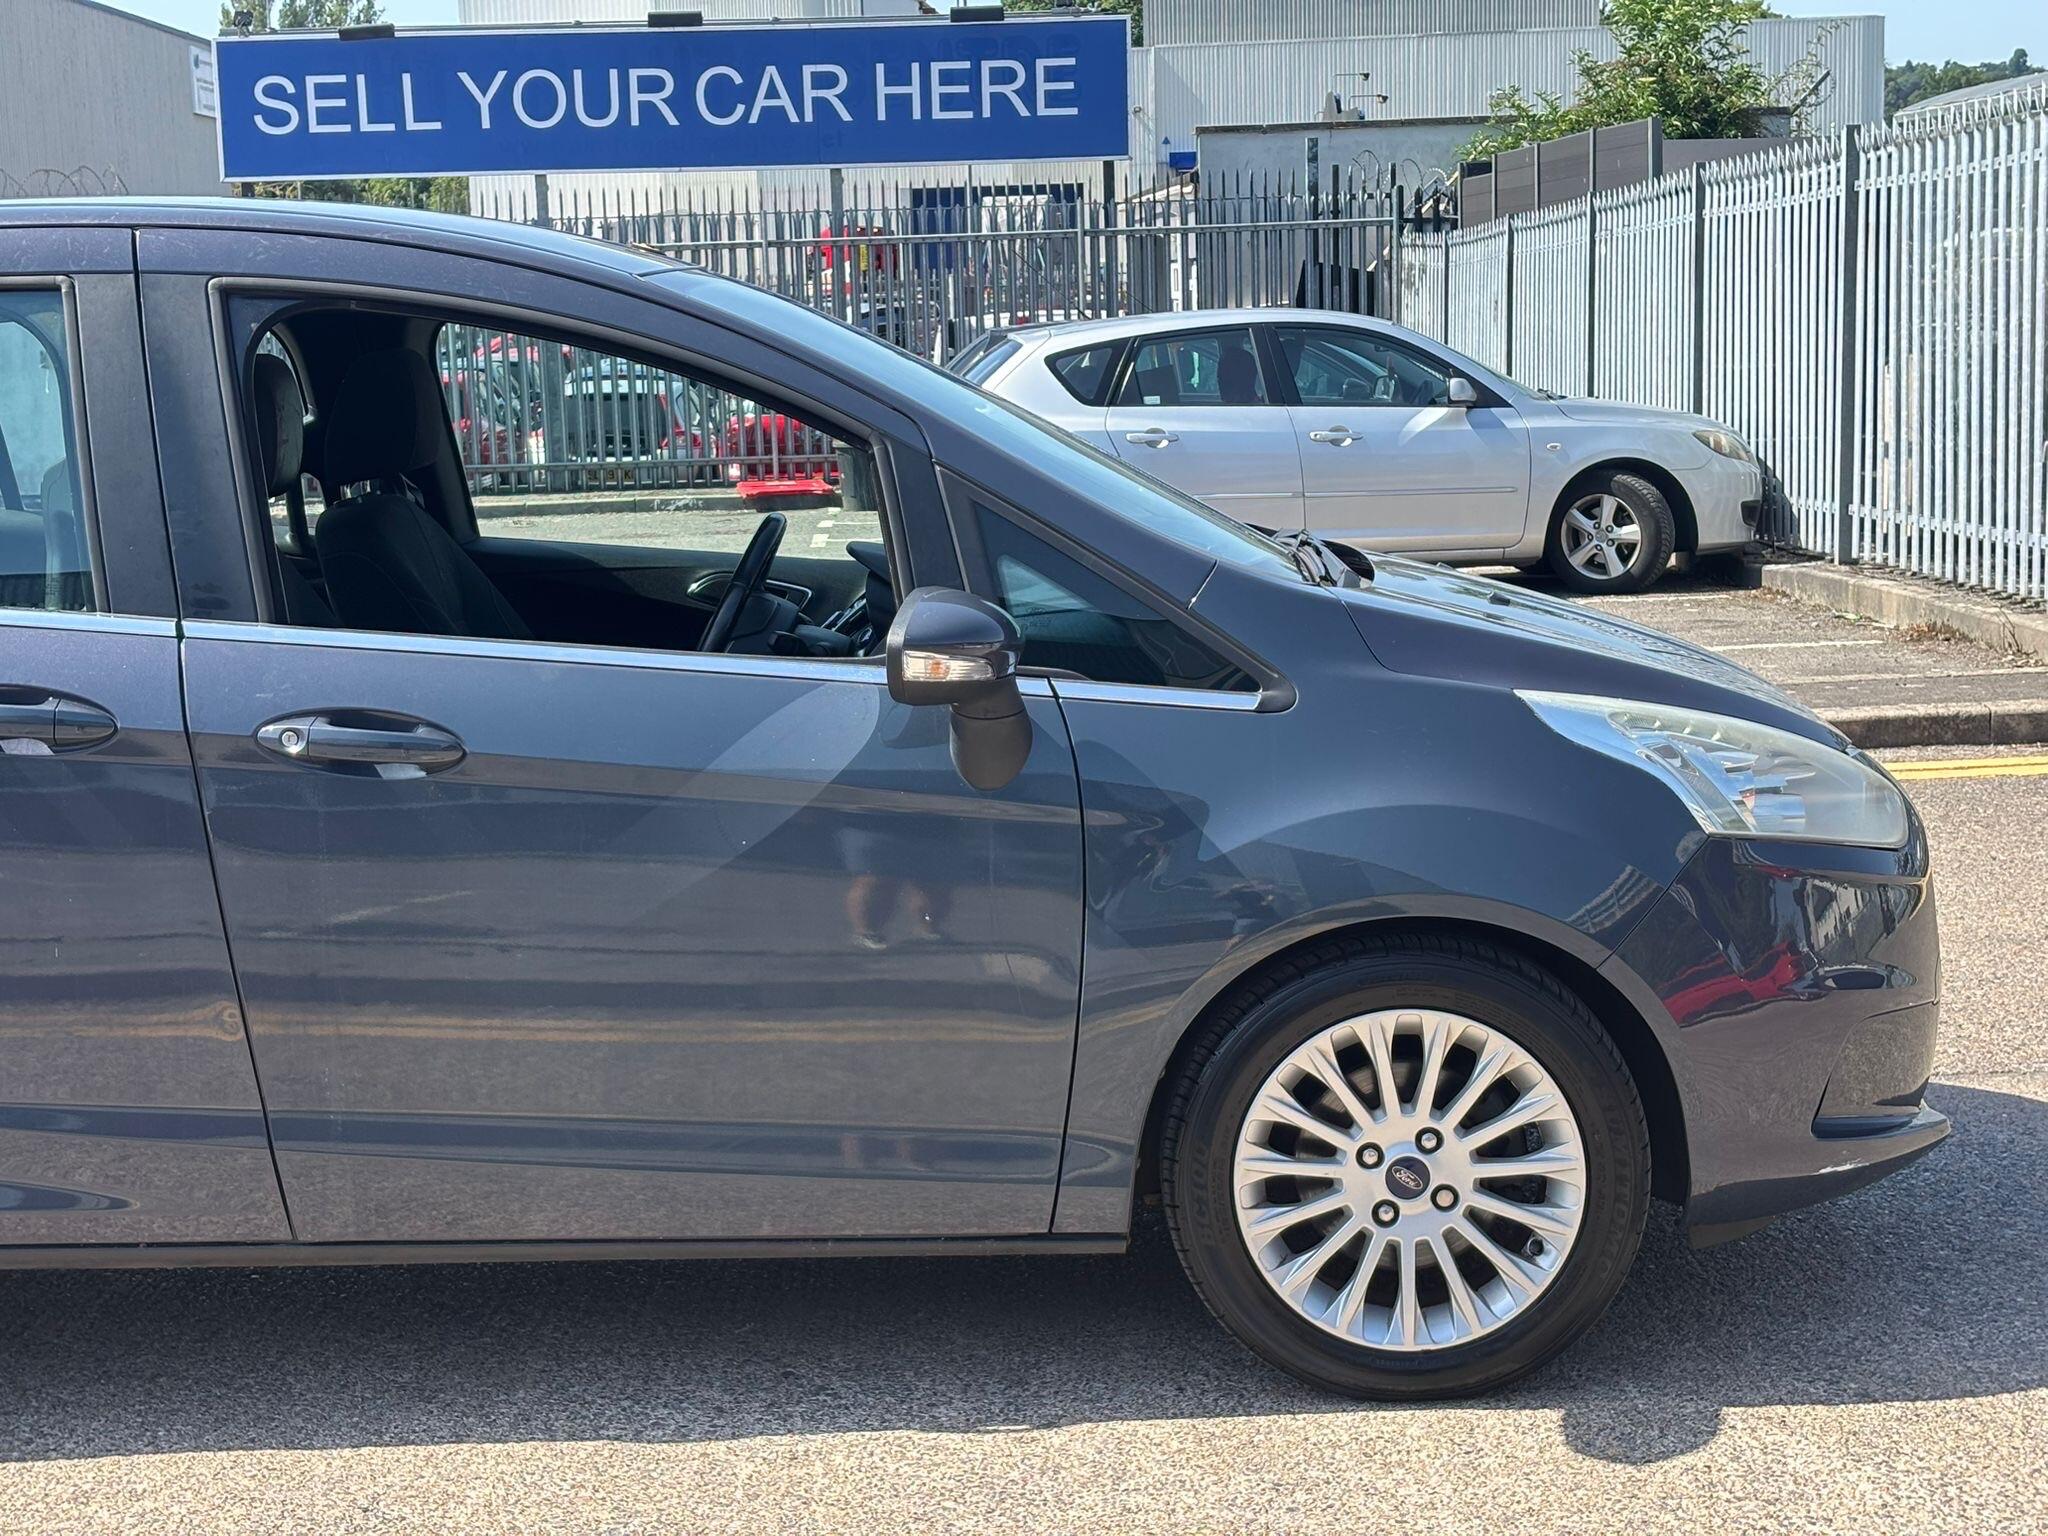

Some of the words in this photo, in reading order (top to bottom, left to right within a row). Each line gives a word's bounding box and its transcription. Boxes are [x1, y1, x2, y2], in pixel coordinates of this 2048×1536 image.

[252, 72, 443, 136] SELL
[456, 67, 681, 130] YOUR
[695, 63, 854, 126] CAR
[875, 56, 1080, 122] HERE
[1395, 1169, 1419, 1186] Ford
